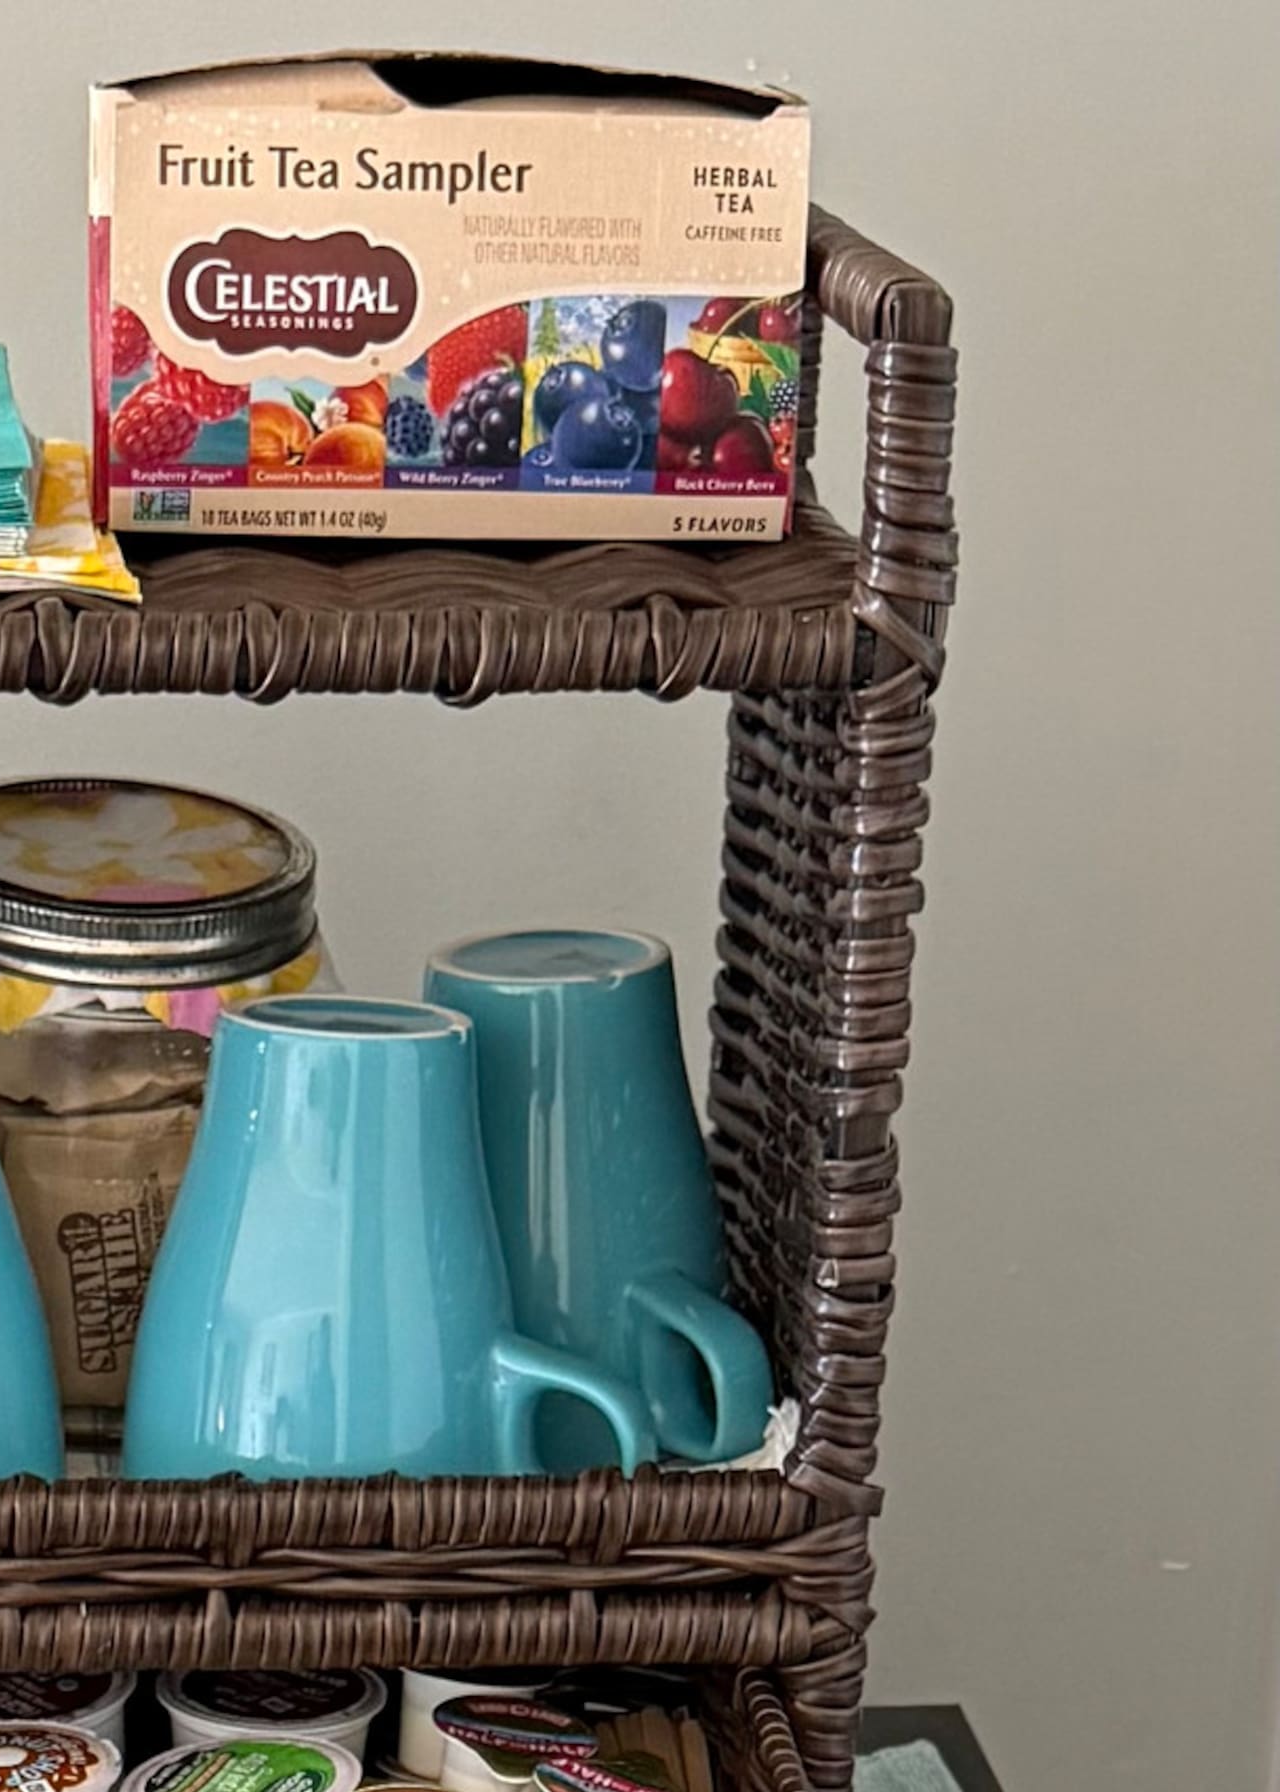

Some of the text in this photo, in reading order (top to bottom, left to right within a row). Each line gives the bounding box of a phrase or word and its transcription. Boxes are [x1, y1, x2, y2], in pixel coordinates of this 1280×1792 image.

[160, 144, 532, 204] Fruit Tea Sampler
[693, 167, 777, 188] HERBAL
[715, 193, 754, 213] TEA
[464, 215, 642, 239] NATURALLY FLAVORED WITH
[685, 225, 783, 242] CAFFEINE FREE
[474, 241, 640, 266] OTHER NATURAL FLAVORS
[185, 259, 399, 322] CELESTIAL
[231, 315, 354, 331] SEASONINGS
[131, 469, 188, 483] Raspberry
[256, 470, 300, 484] Country
[399, 472, 426, 484] Wild
[427, 472, 458, 487] Berry
[675, 478, 775, 492] Black Cherry Berry
[218, 510, 239, 526] TEA
[241, 510, 271, 526] BAGS
[275, 510, 296, 527] NET
[299, 511, 317, 527] WT
[320, 511, 337, 528] 1.4
[340, 511, 355, 528] OZ
[673, 516, 767, 533] 5 FLAVORS
[100, 1209, 139, 1292] THE
[70, 1246, 116, 1373] SUGAR
[448, 1726, 508, 1746] HALF
[551, 1756, 611, 1786] HALF
